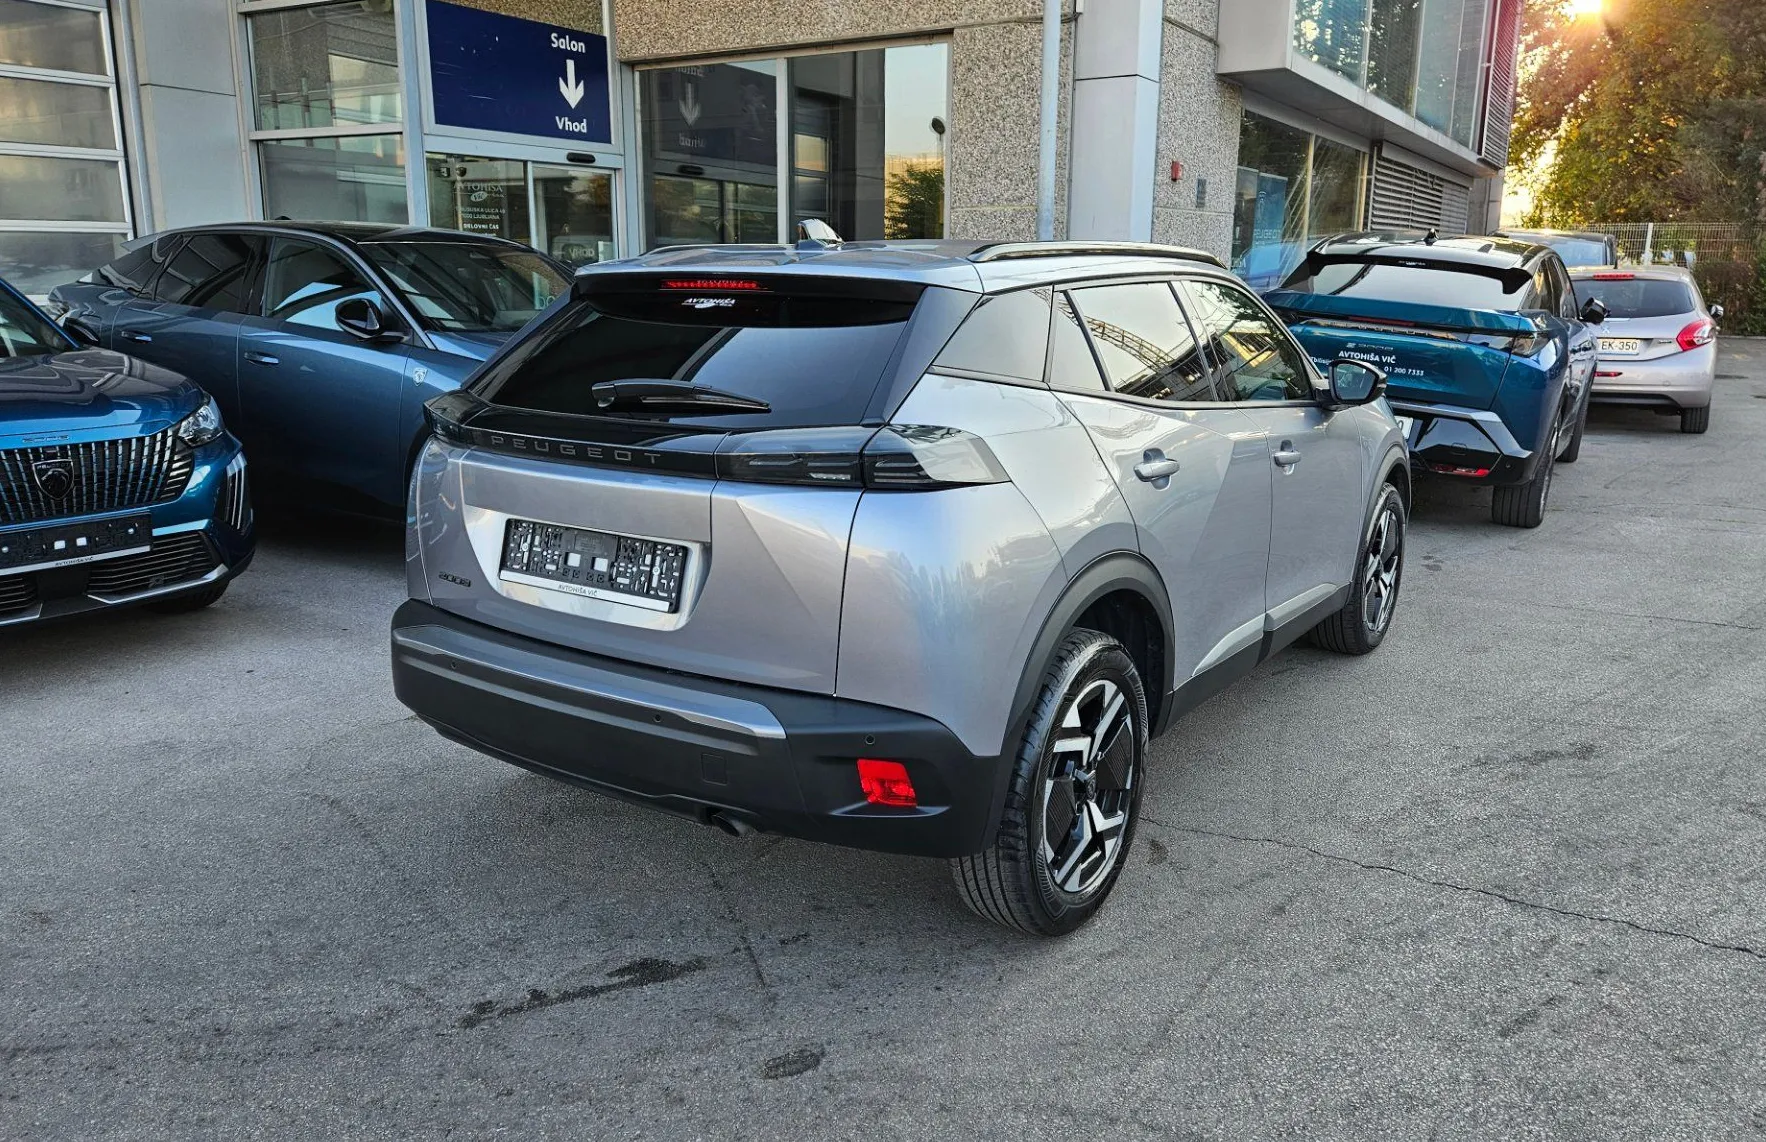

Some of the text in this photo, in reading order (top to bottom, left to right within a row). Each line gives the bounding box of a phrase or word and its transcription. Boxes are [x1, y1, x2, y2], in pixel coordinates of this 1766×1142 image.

[550, 32, 586, 54] Salon
[555, 115, 588, 133] Vhod
[1601, 341, 1638, 351] EK-350
[1338, 350, 1397, 364] AVTOHIŠA VIČ
[491, 435, 661, 464] PEUGEOT
